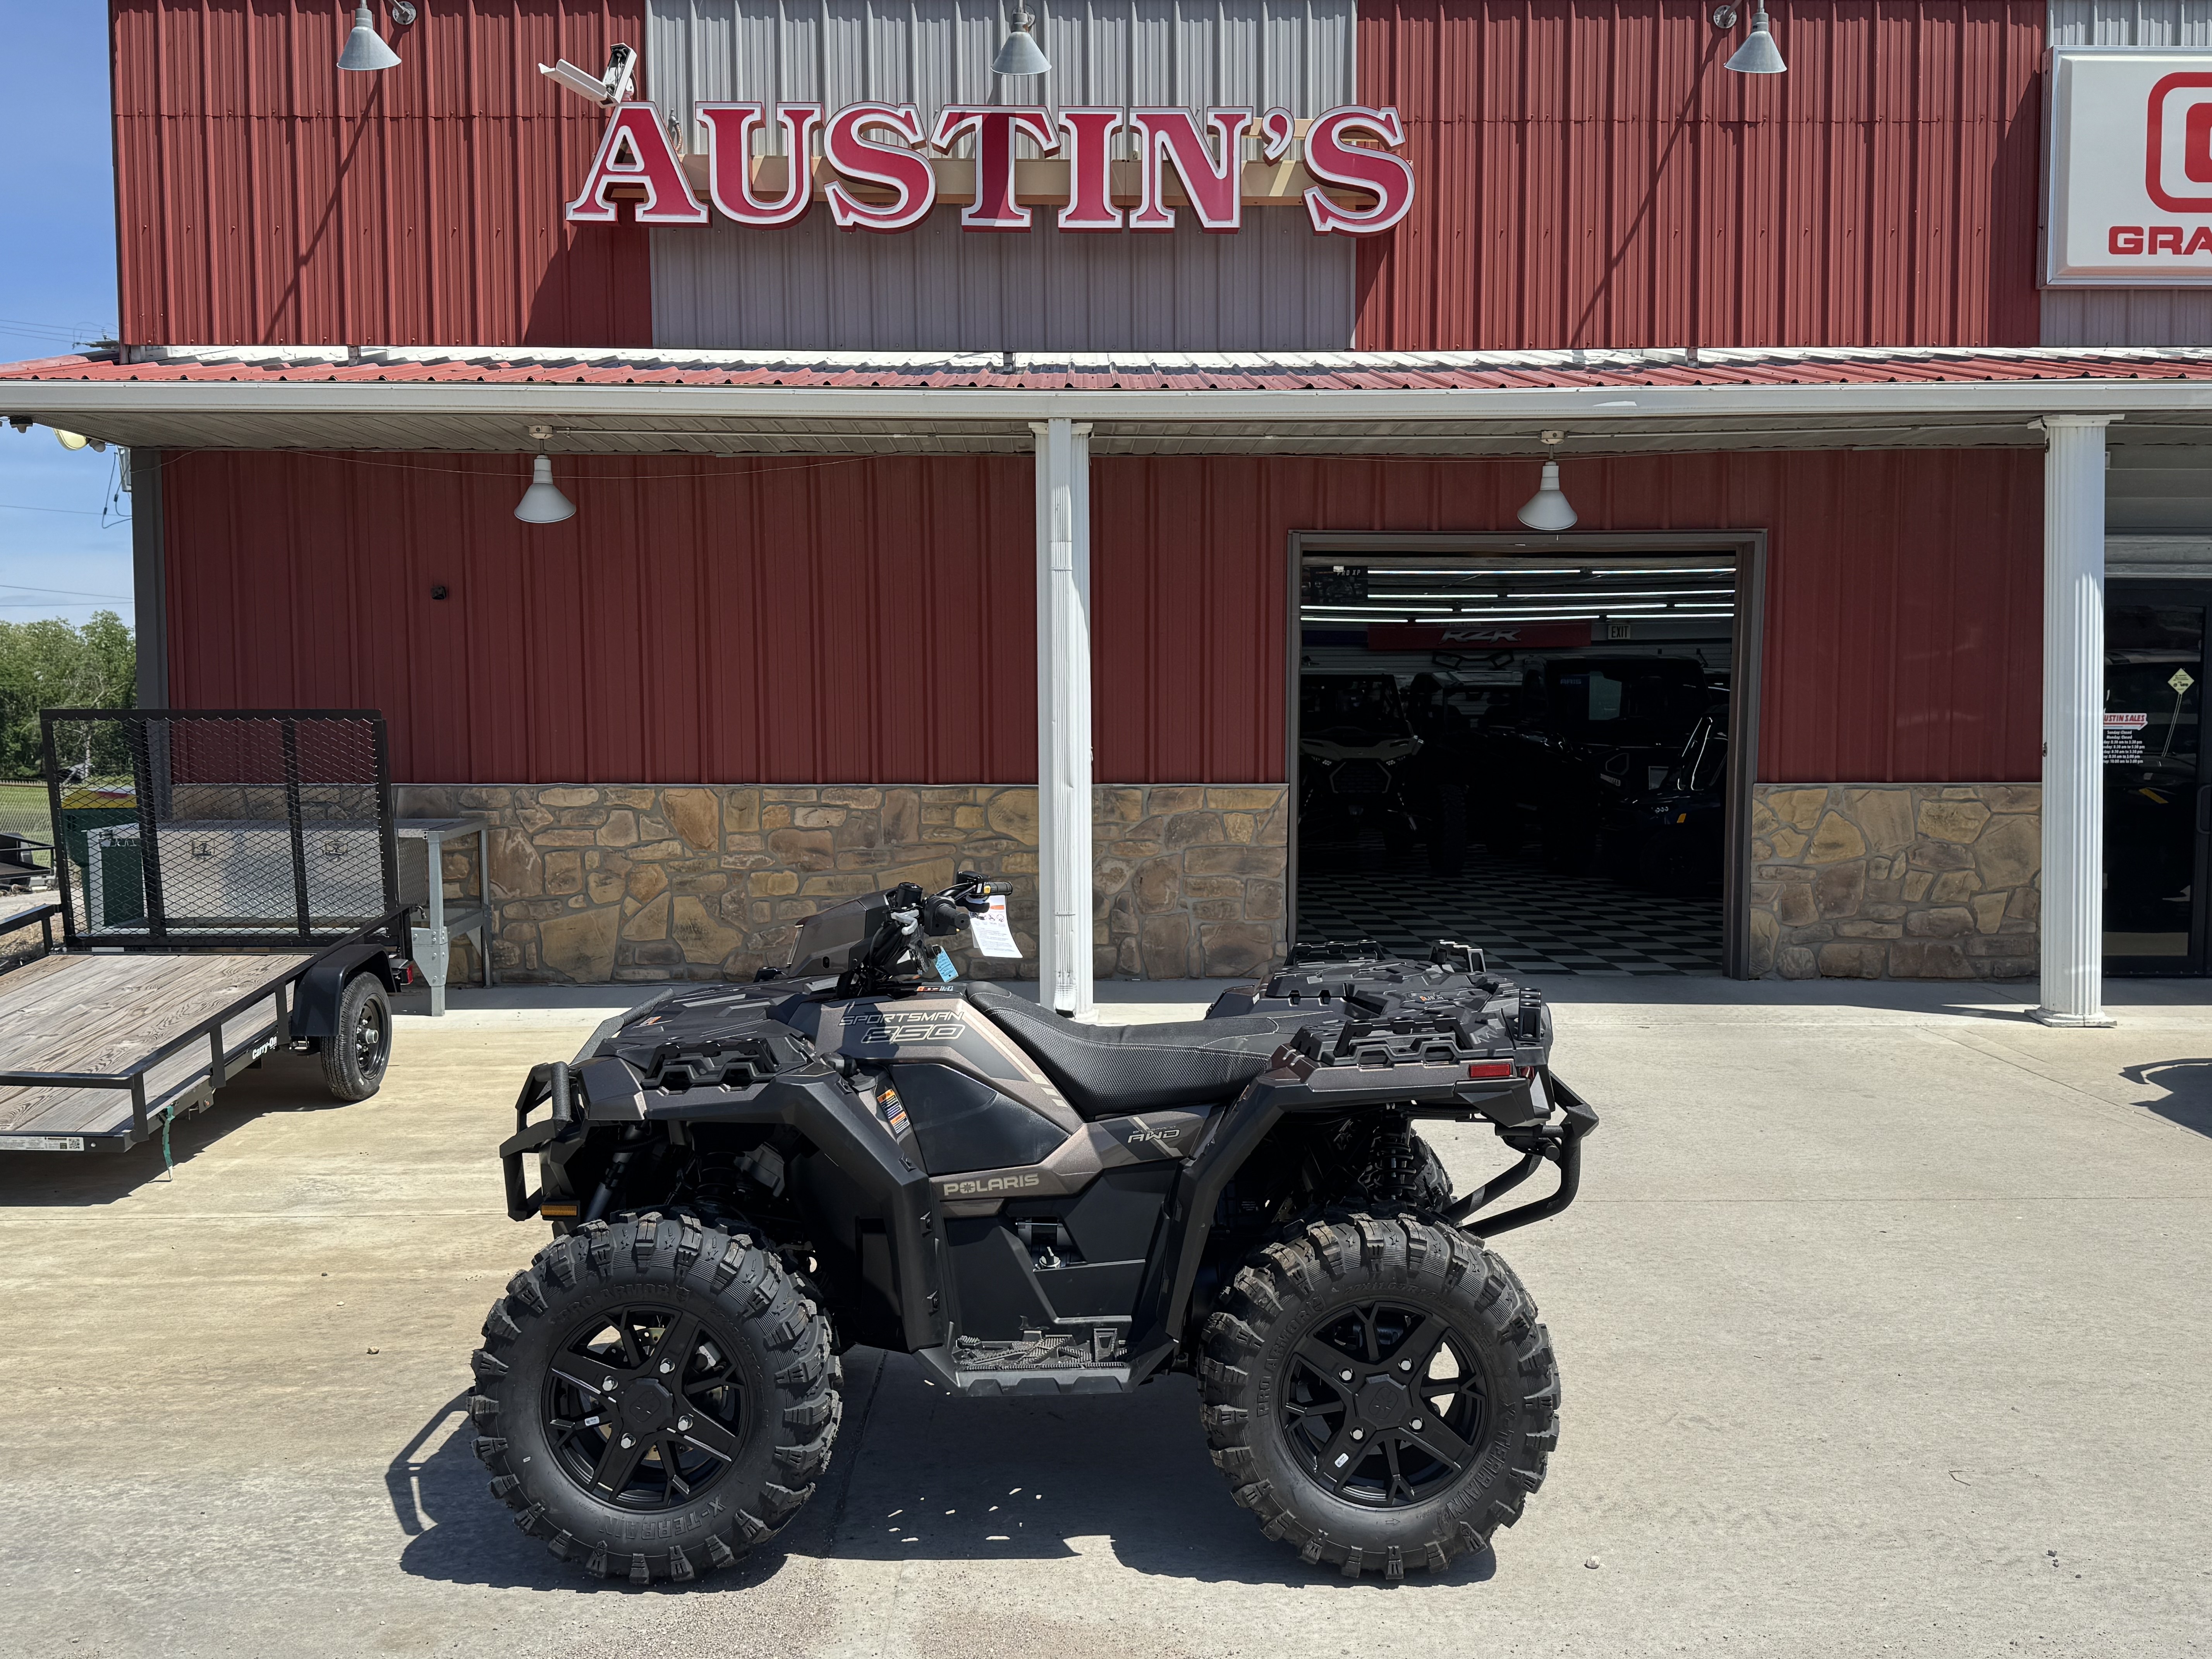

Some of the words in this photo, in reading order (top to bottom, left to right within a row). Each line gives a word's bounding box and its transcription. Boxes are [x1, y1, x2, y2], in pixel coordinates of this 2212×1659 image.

[565, 101, 1416, 236] AUSTIN'S
[1437, 626, 1521, 645] RZR
[1611, 625, 1629, 638] EXIT
[838, 1011, 964, 1027] SPORTSMAN
[861, 1024, 966, 1044] 850
[252, 1036, 277, 1060] Carry-On
[1127, 1129, 1180, 1143] AWD
[943, 1173, 1040, 1196] POLARIS
[1266, 1310, 1311, 1370] ARMOR
